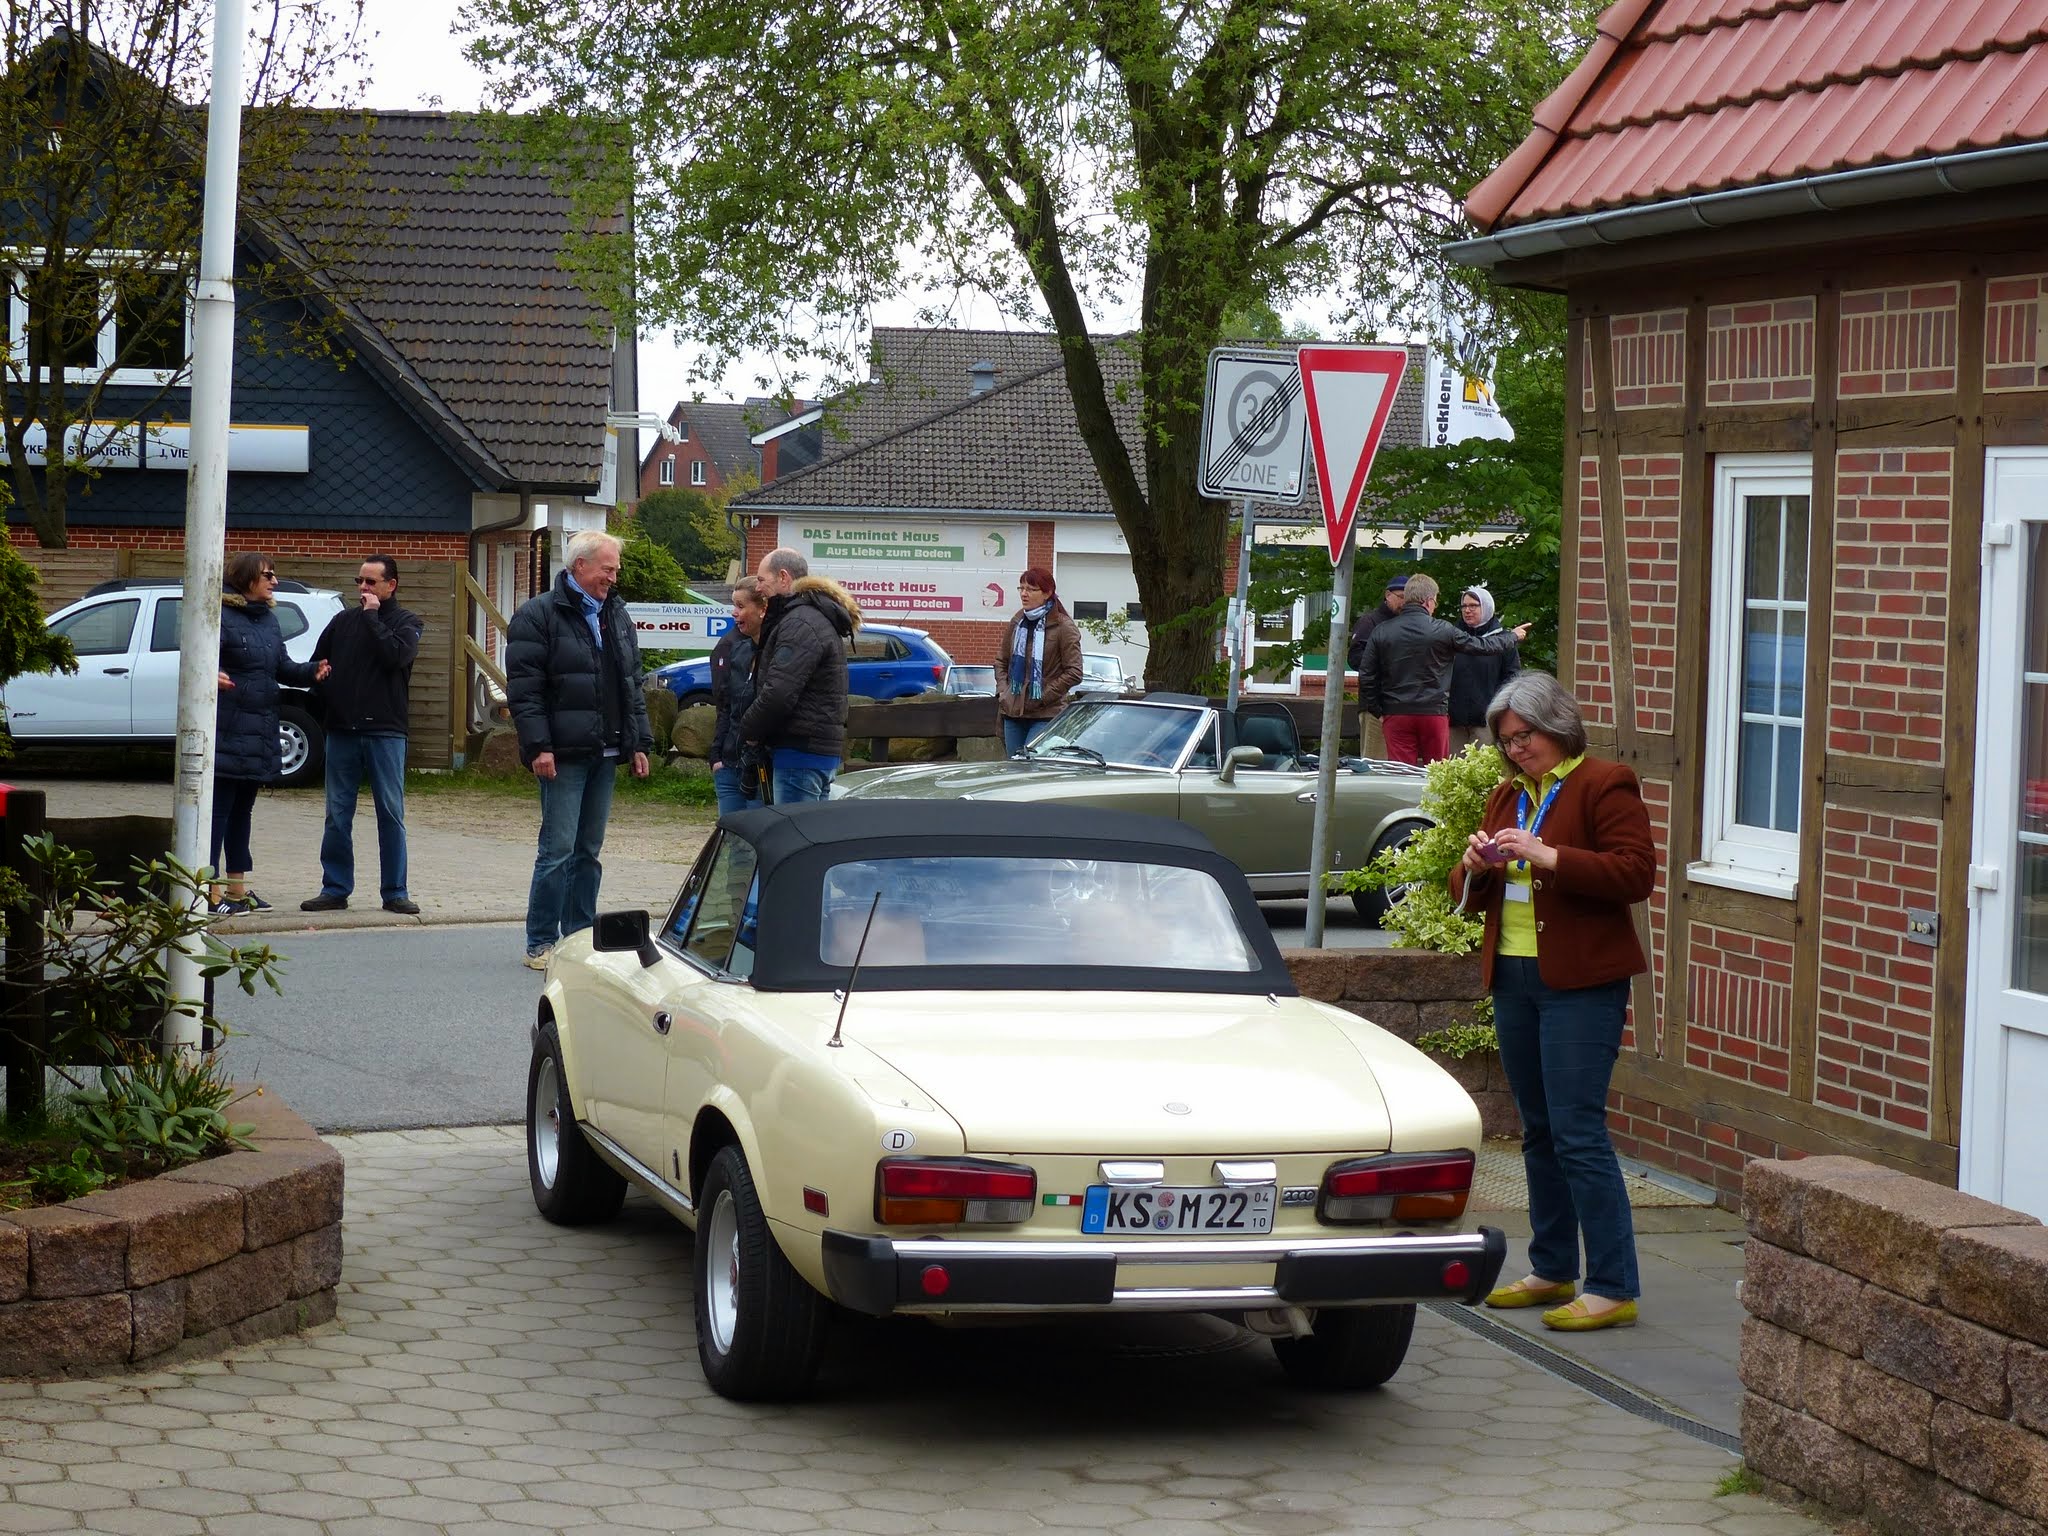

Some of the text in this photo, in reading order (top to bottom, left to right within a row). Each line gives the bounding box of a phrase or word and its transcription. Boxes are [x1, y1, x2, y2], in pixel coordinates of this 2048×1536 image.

[1240, 394, 1277, 434] 30
[171, 449, 189, 459] VIE
[1230, 463, 1278, 486] ZONE
[803, 529, 940, 543] DAS Laminat Haus
[826, 547, 952, 559] Aus Liebe zum Boden
[838, 580, 937, 593] Parkett Haus
[856, 597, 951, 609] iebe zum Boden
[661, 605, 725, 615] TAVERNA RHODOS
[659, 622, 691, 631] oHG
[711, 619, 727, 635] P
[892, 1133, 905, 1149] D
[1254, 1192, 1269, 1203] 04
[1107, 1192, 1153, 1228] KS
[1090, 1214, 1099, 1225] D
[1253, 1217, 1266, 1228] 10
